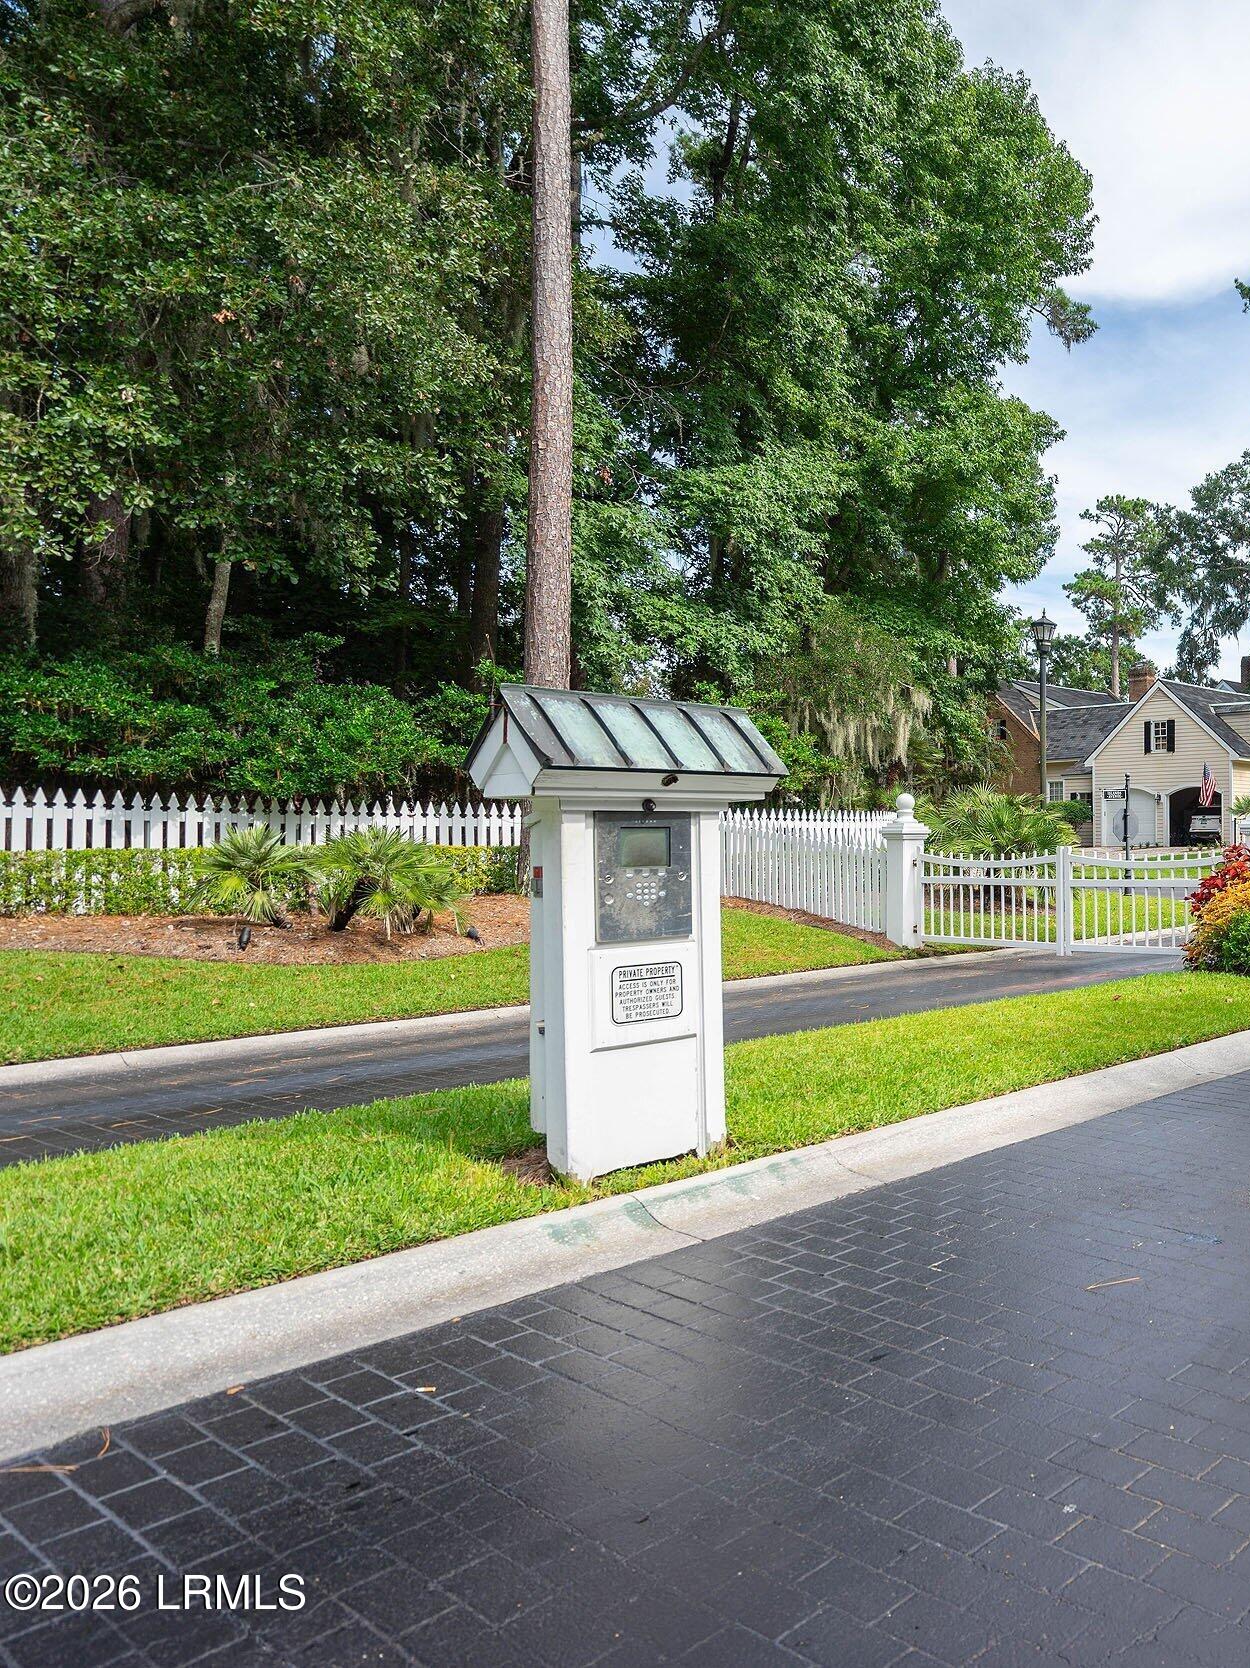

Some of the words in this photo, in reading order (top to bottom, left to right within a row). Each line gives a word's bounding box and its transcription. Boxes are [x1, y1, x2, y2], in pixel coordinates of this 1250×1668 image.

[618, 968, 643, 978] PRIVATE
[645, 965, 675, 976] PROPERTY
[618, 982, 640, 990] ACCESS
[614, 989, 643, 998] PROPERTY
[645, 987, 667, 995] OWNERS
[619, 995, 653, 1005] AUTHORIZED
[622, 1002, 659, 1012] TRESPASSERS
